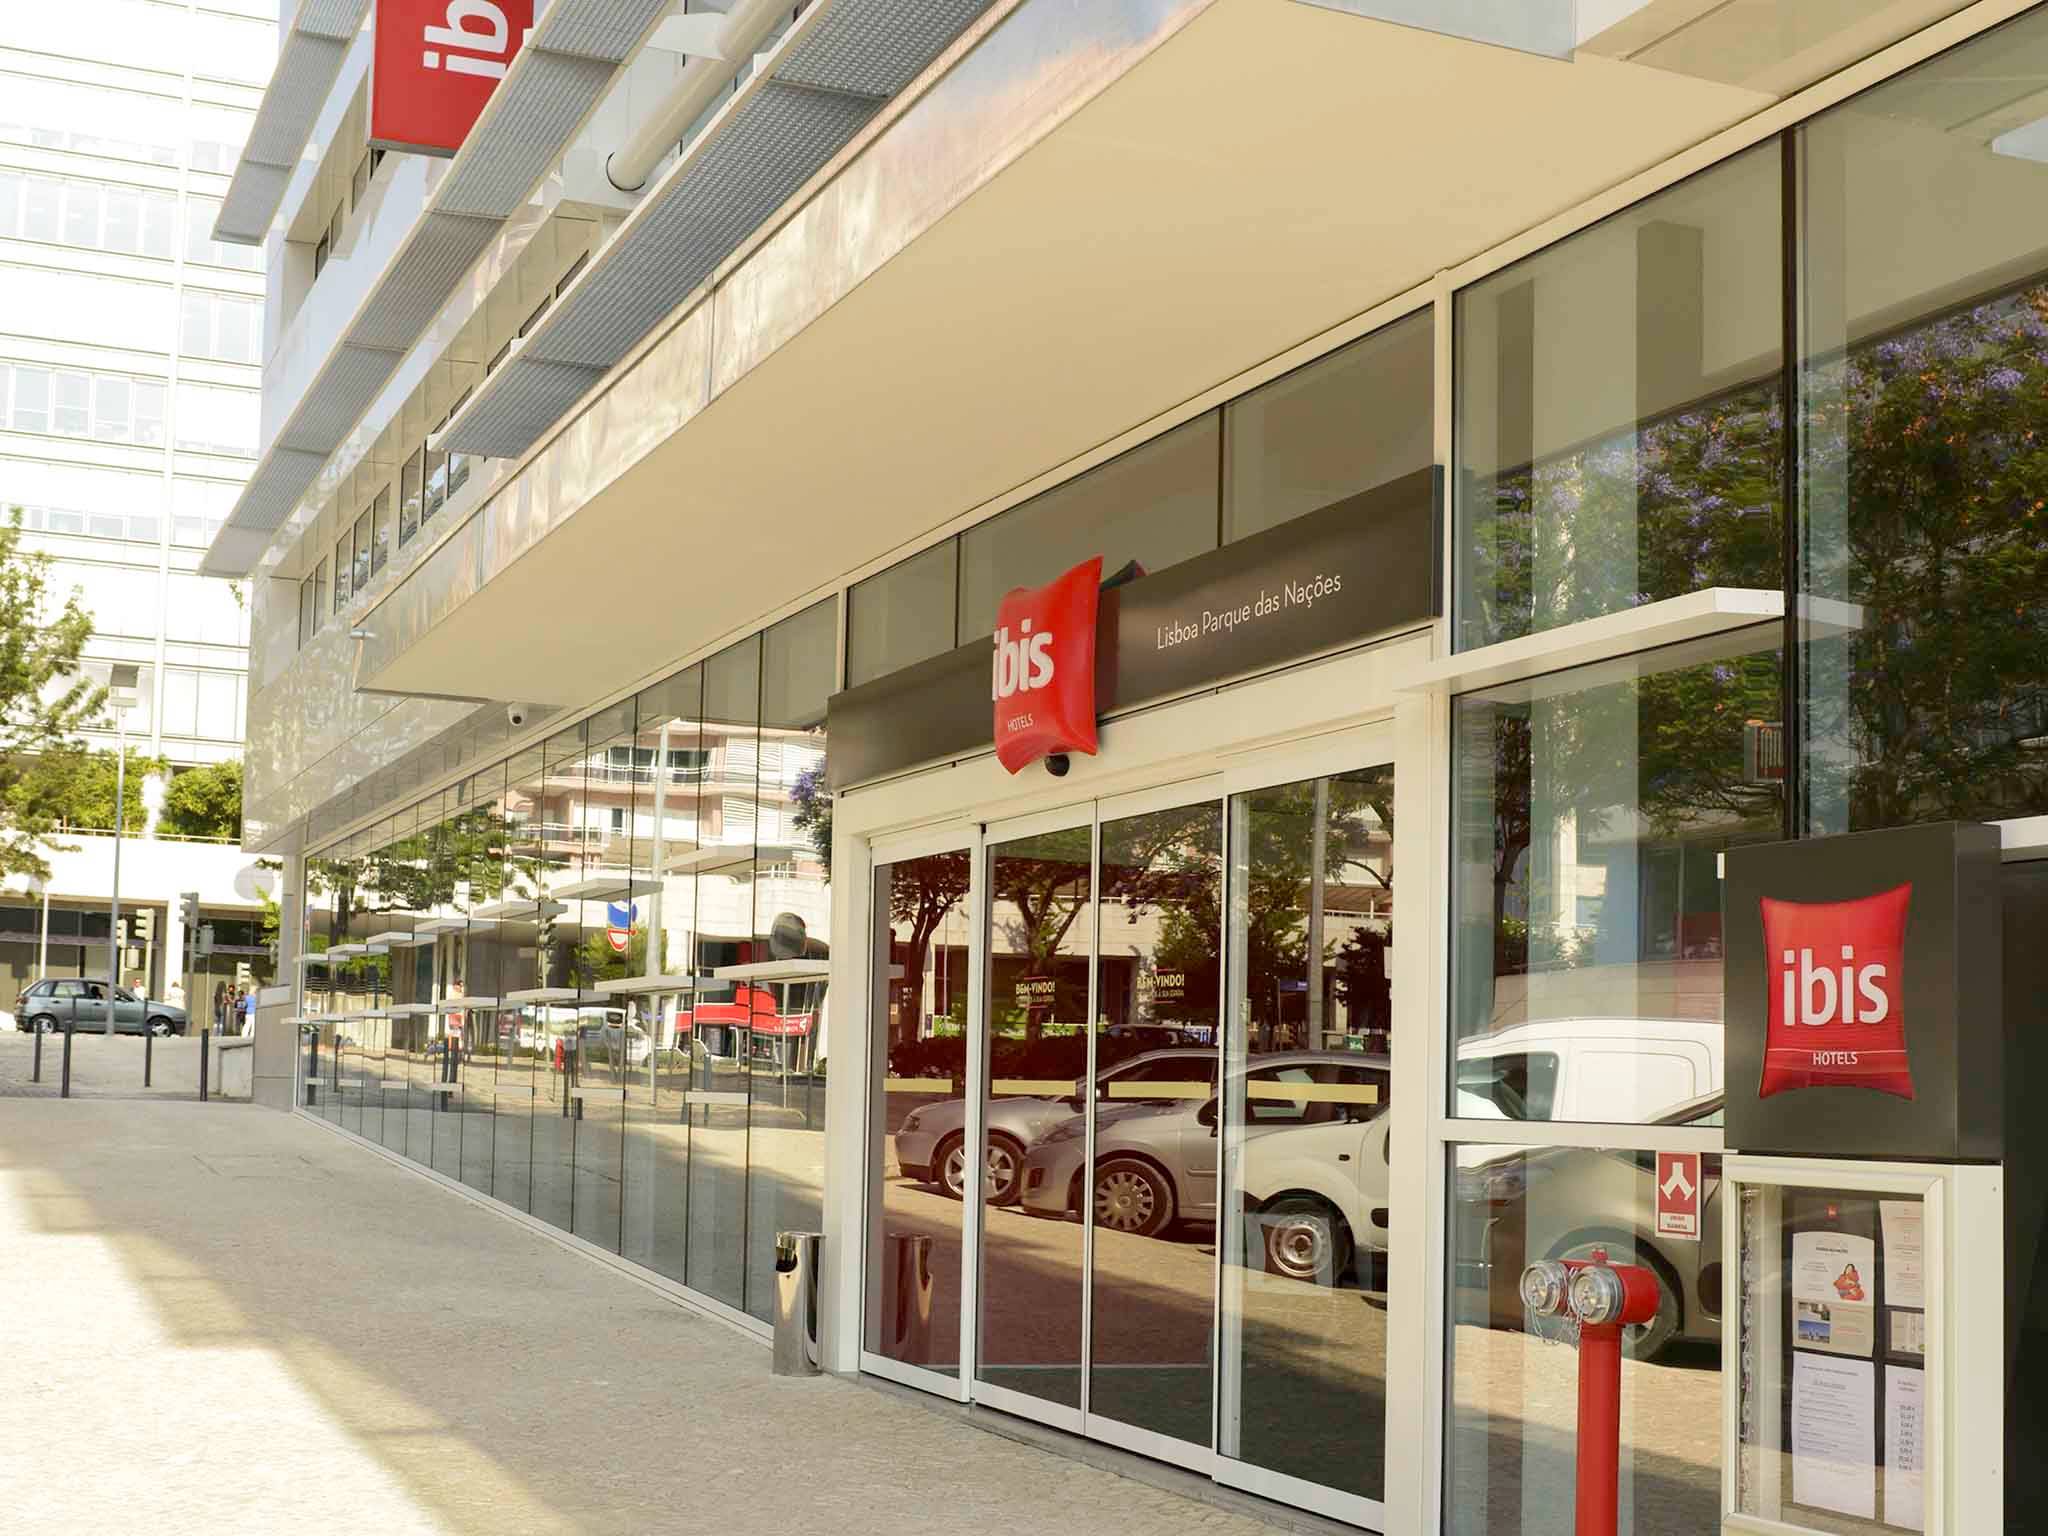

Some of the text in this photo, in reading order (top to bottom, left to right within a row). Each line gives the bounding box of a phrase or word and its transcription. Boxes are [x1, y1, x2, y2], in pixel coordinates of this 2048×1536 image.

[1157, 574, 1342, 649] Lisboa Parque das Nações
[992, 618, 1054, 701] ibis
[1008, 713, 1033, 731] HOTELS
[1783, 944, 1888, 1026] ibis
[1813, 1051, 1858, 1066] HOTELS
